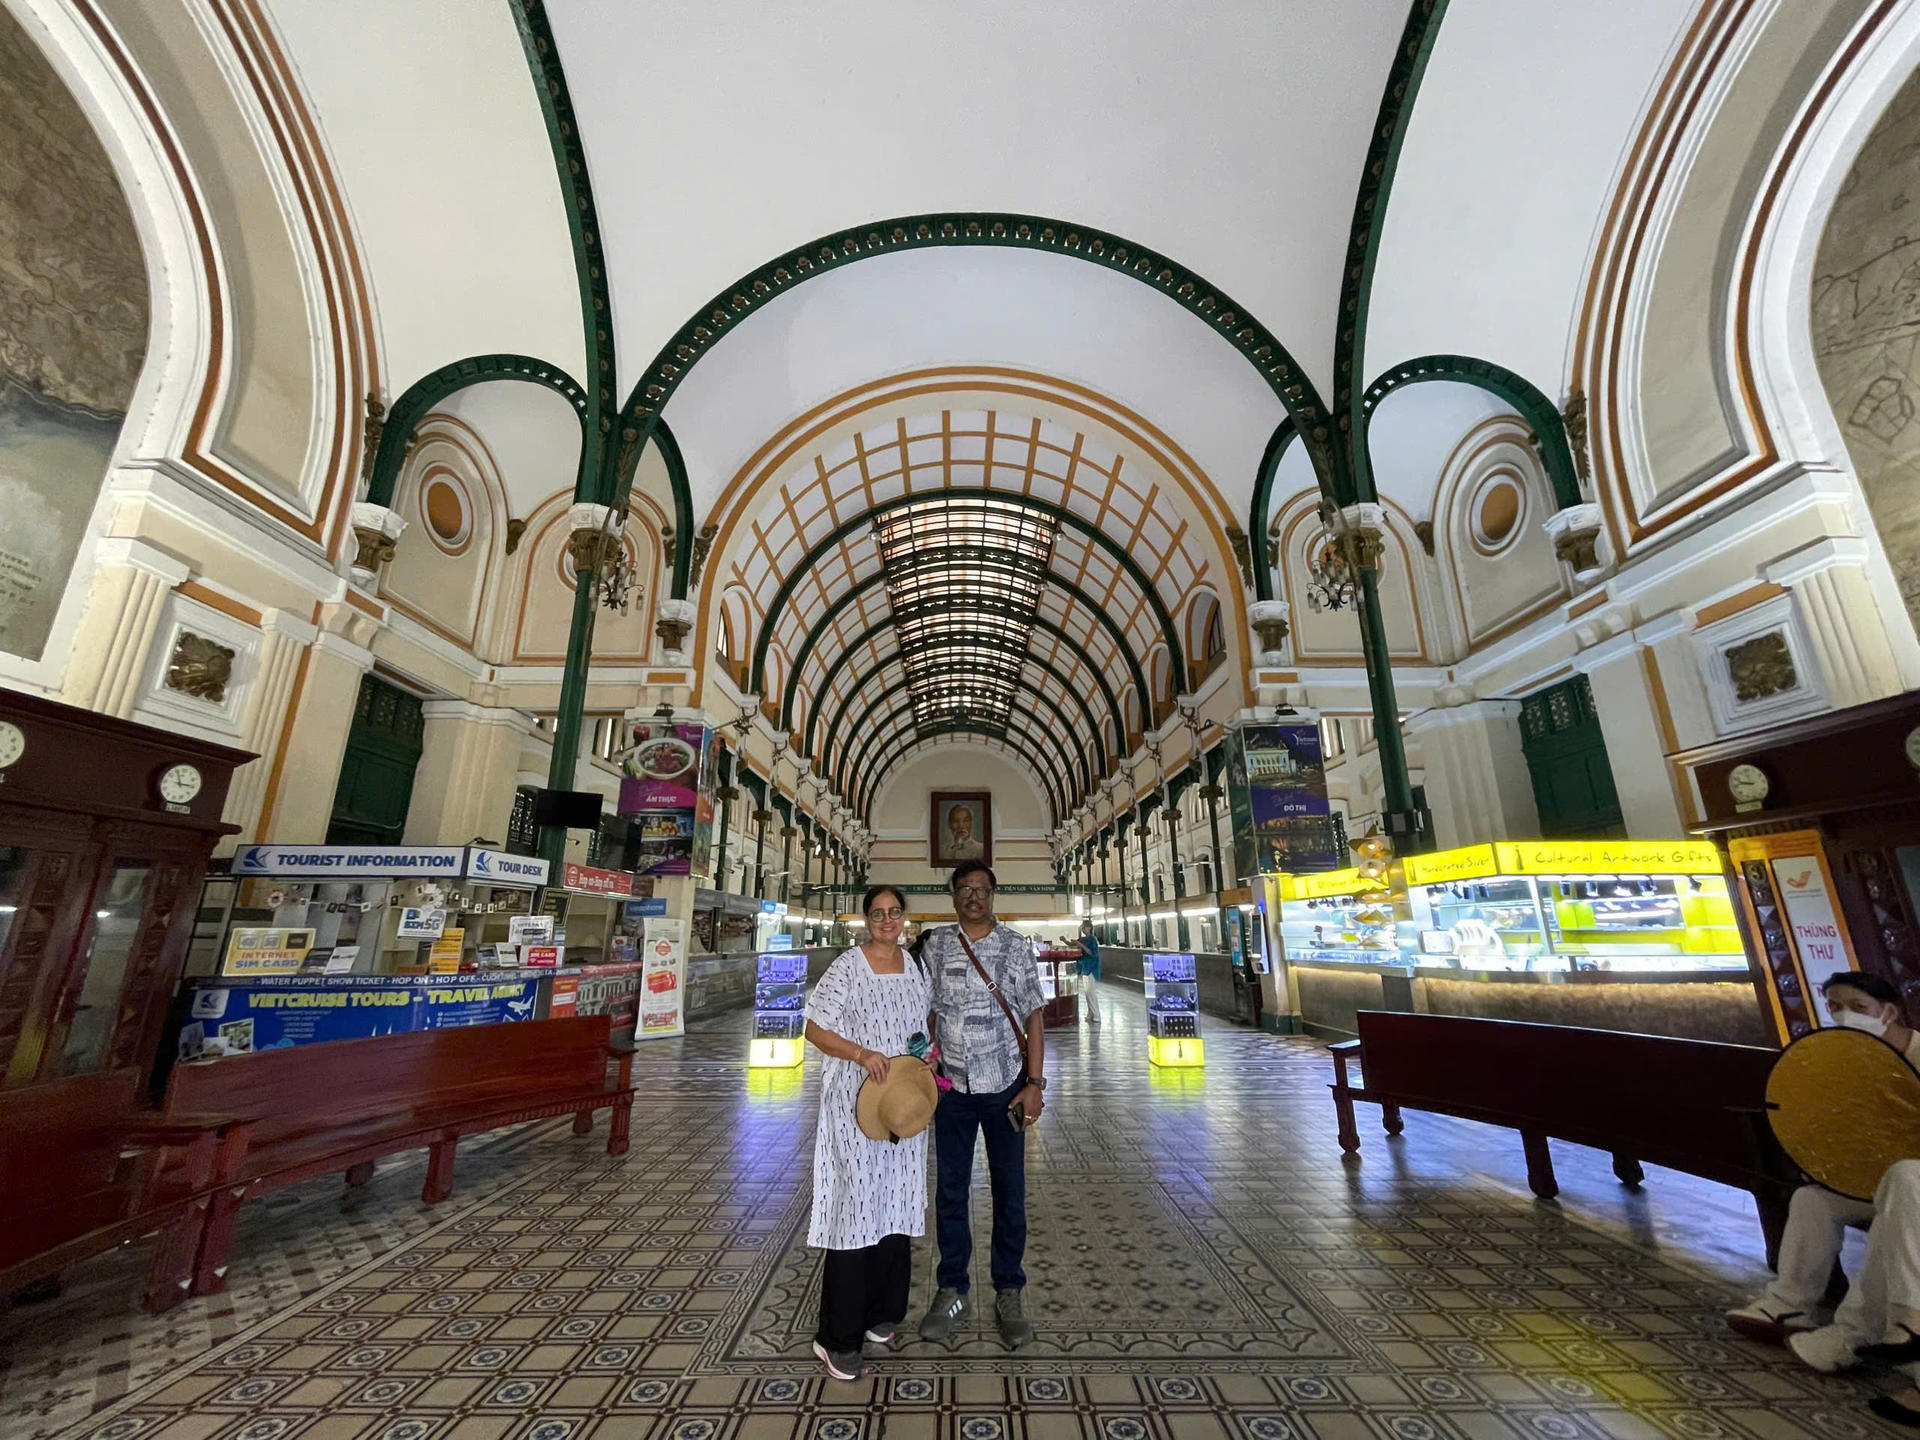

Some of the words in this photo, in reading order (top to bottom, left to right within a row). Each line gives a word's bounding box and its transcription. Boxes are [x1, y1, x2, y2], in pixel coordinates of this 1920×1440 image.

[278, 854, 344, 866] TOURIST
[346, 854, 456, 868] INFORMATION
[1536, 851, 1592, 864] Cultural
[1603, 851, 1664, 863] Artwork
[1672, 850, 1712, 863] Gifts
[498, 860, 522, 874] TOUR
[522, 864, 542, 876] DESK
[1796, 922, 1836, 938] THÙNG
[241, 951, 296, 959] INTERNET
[1807, 944, 1834, 960] THƯ
[235, 960, 259, 968] SIM
[262, 960, 300, 968] CARD
[292, 978, 326, 986] PUPPET
[356, 977, 386, 985] TICKET
[392, 976, 412, 984] HOP
[413, 976, 428, 984] ON
[436, 976, 456, 984] HOP
[458, 975, 476, 983] OFF
[248, 993, 348, 1008] VIETCRUISE
[350, 991, 410, 1007] TOURS
[427, 987, 490, 1004] TRAVEL
[491, 982, 525, 1000] AGENCY
